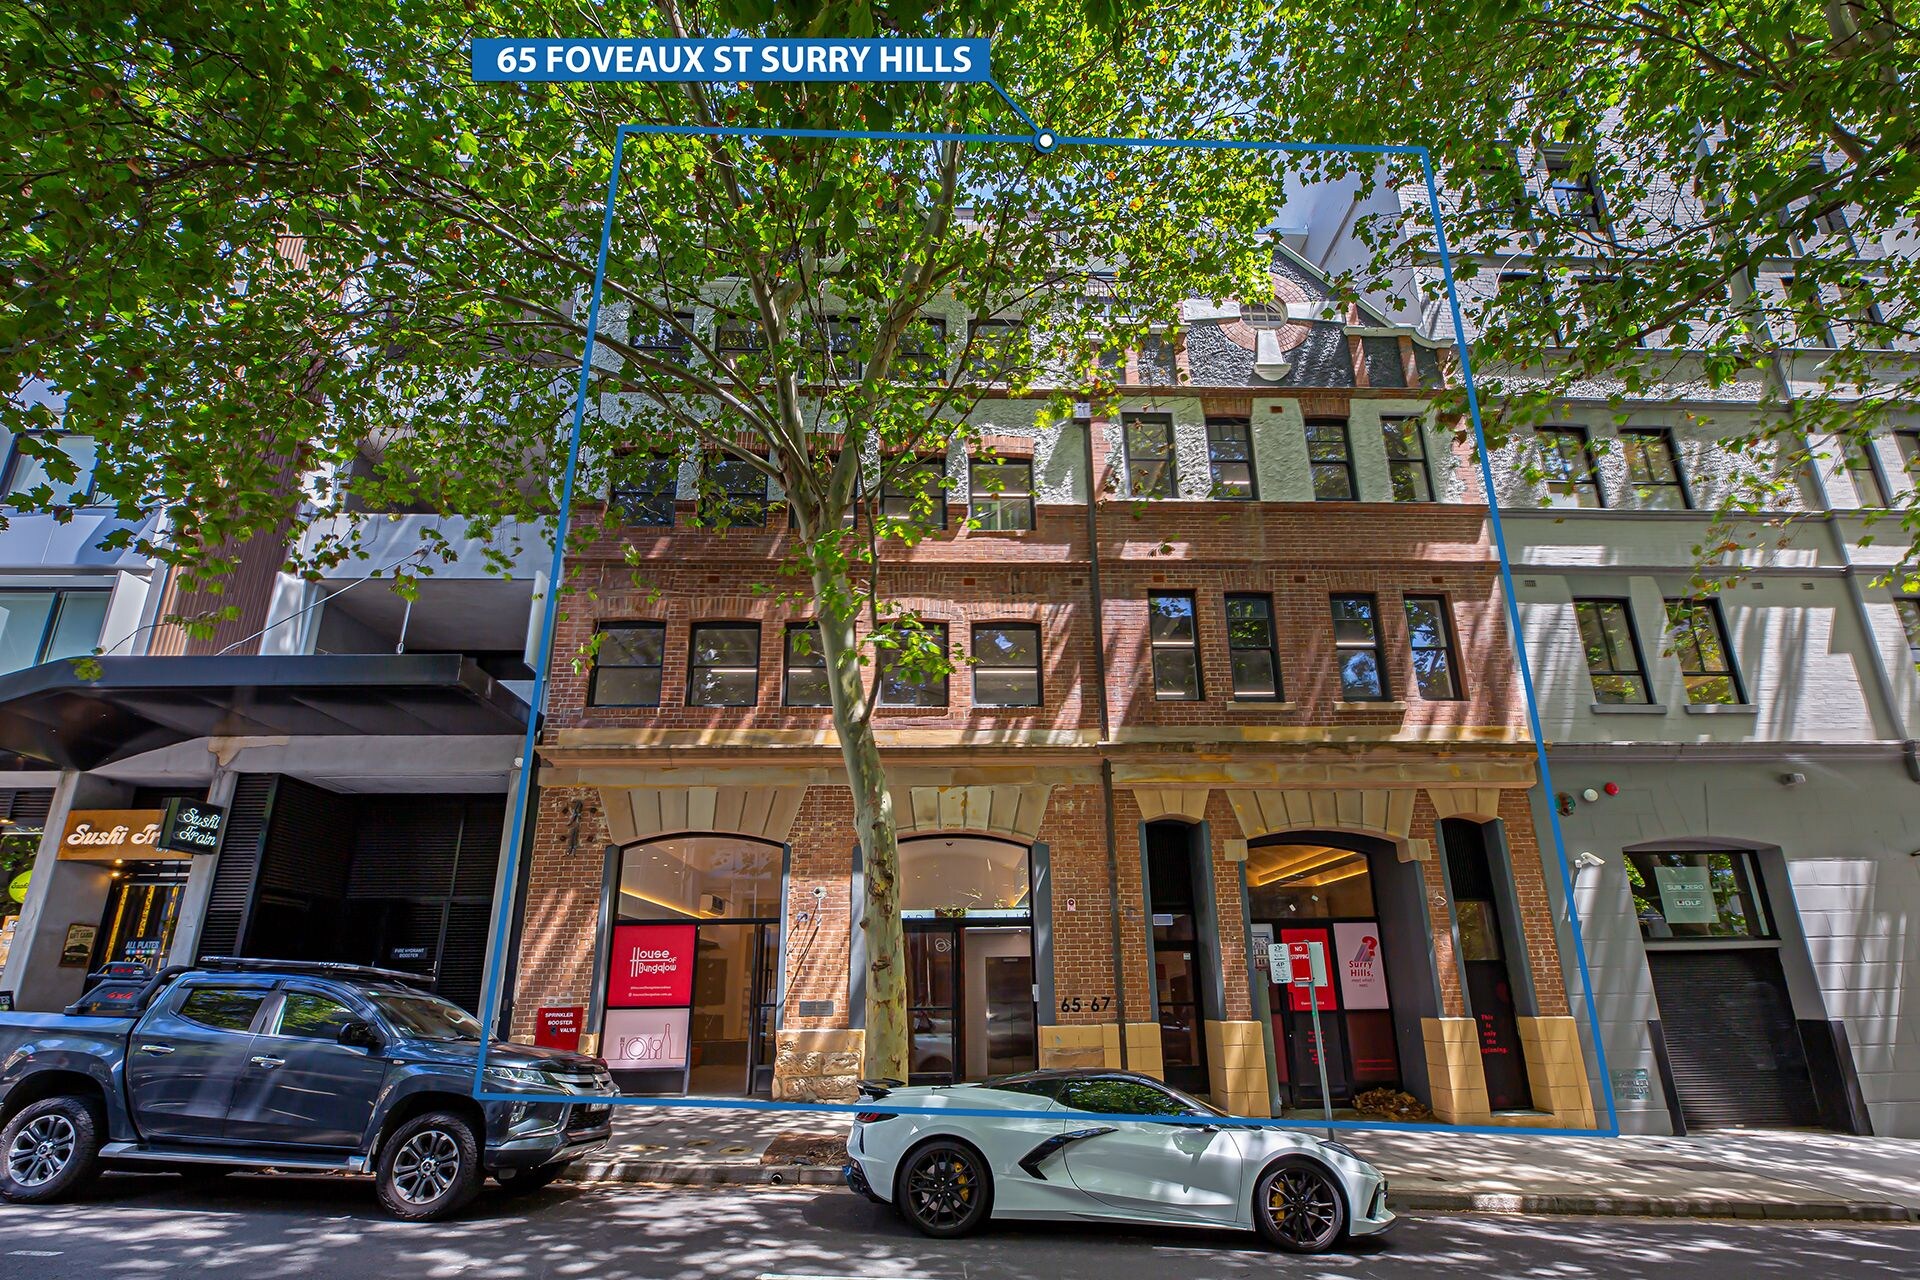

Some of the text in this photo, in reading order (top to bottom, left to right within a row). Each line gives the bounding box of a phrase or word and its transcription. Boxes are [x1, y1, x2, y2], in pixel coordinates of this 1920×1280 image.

[183, 808, 221, 830] Sushi
[67, 823, 129, 845] Sushi
[179, 825, 216, 846] Train
[125, 940, 160, 949] ALL PLATES
[630, 947, 670, 978] House
[639, 962, 677, 974] Bungalow
[1349, 960, 1373, 969] Surry
[1061, 997, 1110, 1012] 65-67
